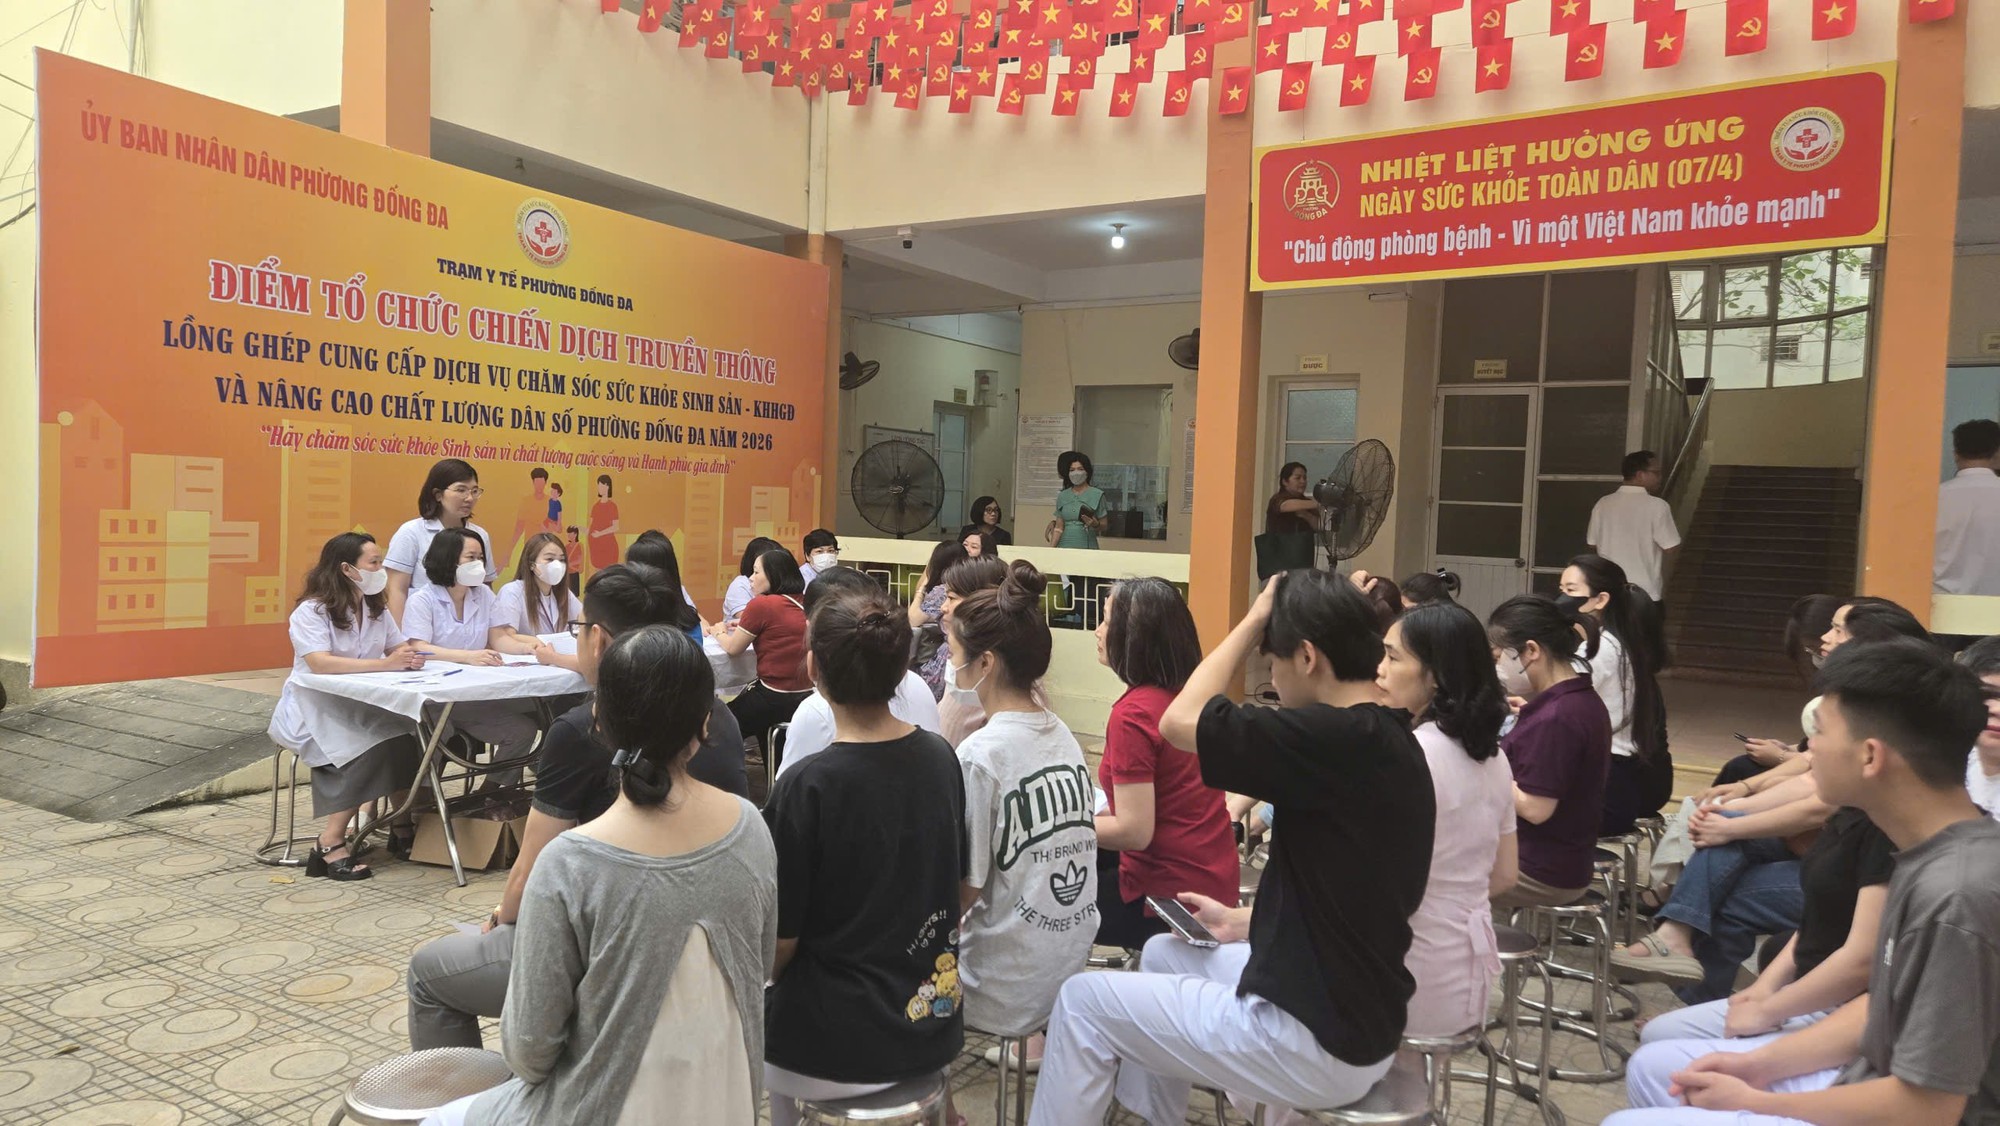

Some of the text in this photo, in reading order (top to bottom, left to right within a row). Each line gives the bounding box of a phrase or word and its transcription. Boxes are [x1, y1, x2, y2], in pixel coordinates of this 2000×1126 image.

[81, 99, 112, 145] ỦY
[120, 118, 168, 157] BAN
[175, 136, 237, 175] NHÂN
[243, 150, 286, 187] DÂN
[373, 184, 422, 223] ĐỐNG
[427, 201, 449, 230] ĐA
[1360, 115, 1745, 184] NHIỆT LIỆT HƯỞNG ỨNG
[1360, 152, 1743, 218] NGÀY SỨC KHỎE TOÀN DÂN (07/4)
[1284, 235, 1326, 264] "Chủ
[1331, 236, 1375, 265] động
[1380, 230, 1438, 260] phòng
[1443, 223, 1492, 257] bệnh
[1512, 218, 1531, 246] Vì
[1537, 216, 1578, 248] một
[1584, 209, 1625, 243] Việt
[1631, 206, 1683, 235] Nam
[1690, 195, 1749, 230] khỏe
[1756, 188, 1840, 228] mạnh"
[436, 257, 634, 311] TRẠM Y TẾ PHƯỜNG ĐỐNG ĐA
[210, 257, 776, 385] ĐIỂM TỔ CHỨC CHIẾN DỊCH TRUYỀN THÔNG
[163, 314, 234, 355] LỒNG
[243, 331, 311, 363] GHÉP
[319, 342, 379, 372] CUNG
[386, 346, 427, 377] CẤP
[433, 357, 480, 385] DỊCH
[487, 364, 511, 391] VỤ
[517, 368, 566, 395] CHĂM
[572, 373, 601, 400] SÓC
[606, 379, 635, 403] SỨC
[639, 383, 678, 409] KHỎE
[682, 390, 714, 413] SINH
[718, 392, 742, 416] SẢN
[214, 373, 773, 451] VÀ NÂNG CAO CHẤT LƯỢNG DÂN SỐ PHƯỜNG ĐỐNG ĐA NĂM 2026
[306, 428, 350, 451] chăm
[352, 432, 376, 452] sóc
[379, 433, 404, 454] sức
[406, 436, 439, 456] khỏe
[440, 438, 470, 458] Sinh
[473, 440, 496, 460] sản
[500, 440, 512, 461] vì
[512, 441, 539, 464] chất
[600, 449, 625, 473] sống
[627, 451, 639, 468] và
[668, 455, 693, 475] phúc
[693, 460, 708, 476] gia
[1014, 896, 1038, 924] THE
[1039, 914, 1072, 932] THREE
